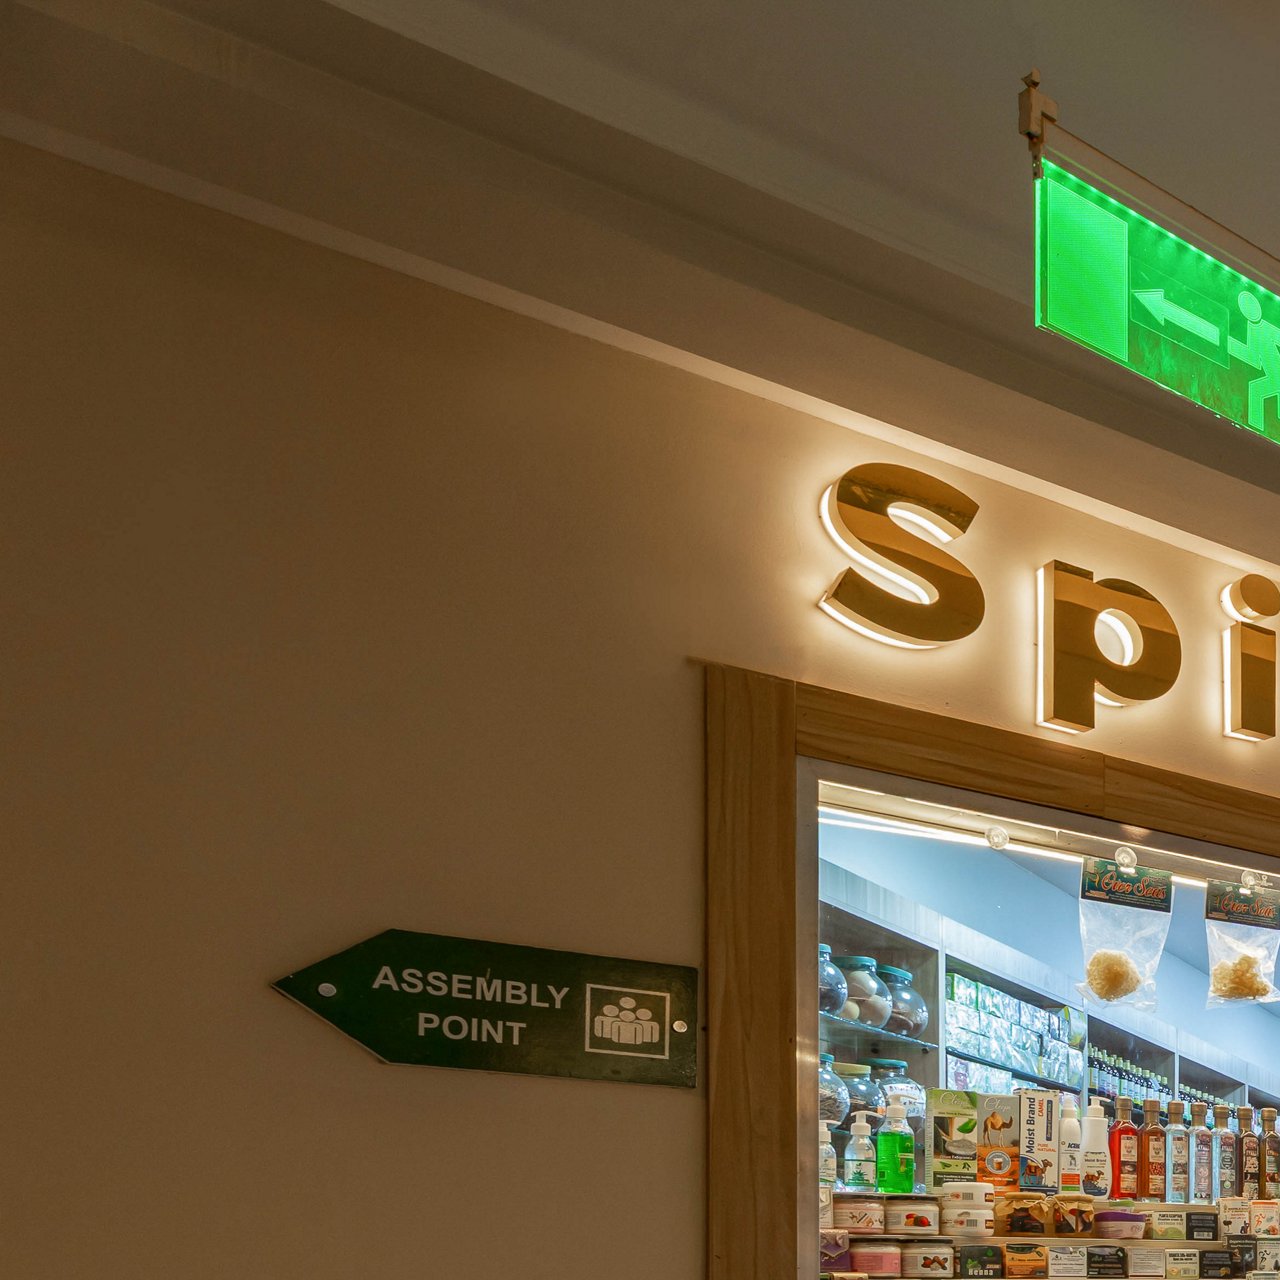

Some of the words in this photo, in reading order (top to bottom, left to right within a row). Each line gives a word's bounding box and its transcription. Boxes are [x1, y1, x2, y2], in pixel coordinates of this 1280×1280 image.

[372, 965, 570, 1010] ASSEMBLY
[417, 1012, 527, 1046] POINT
[1026, 1097, 1036, 1126] Brand
[1025, 1128, 1035, 1154] Moist
